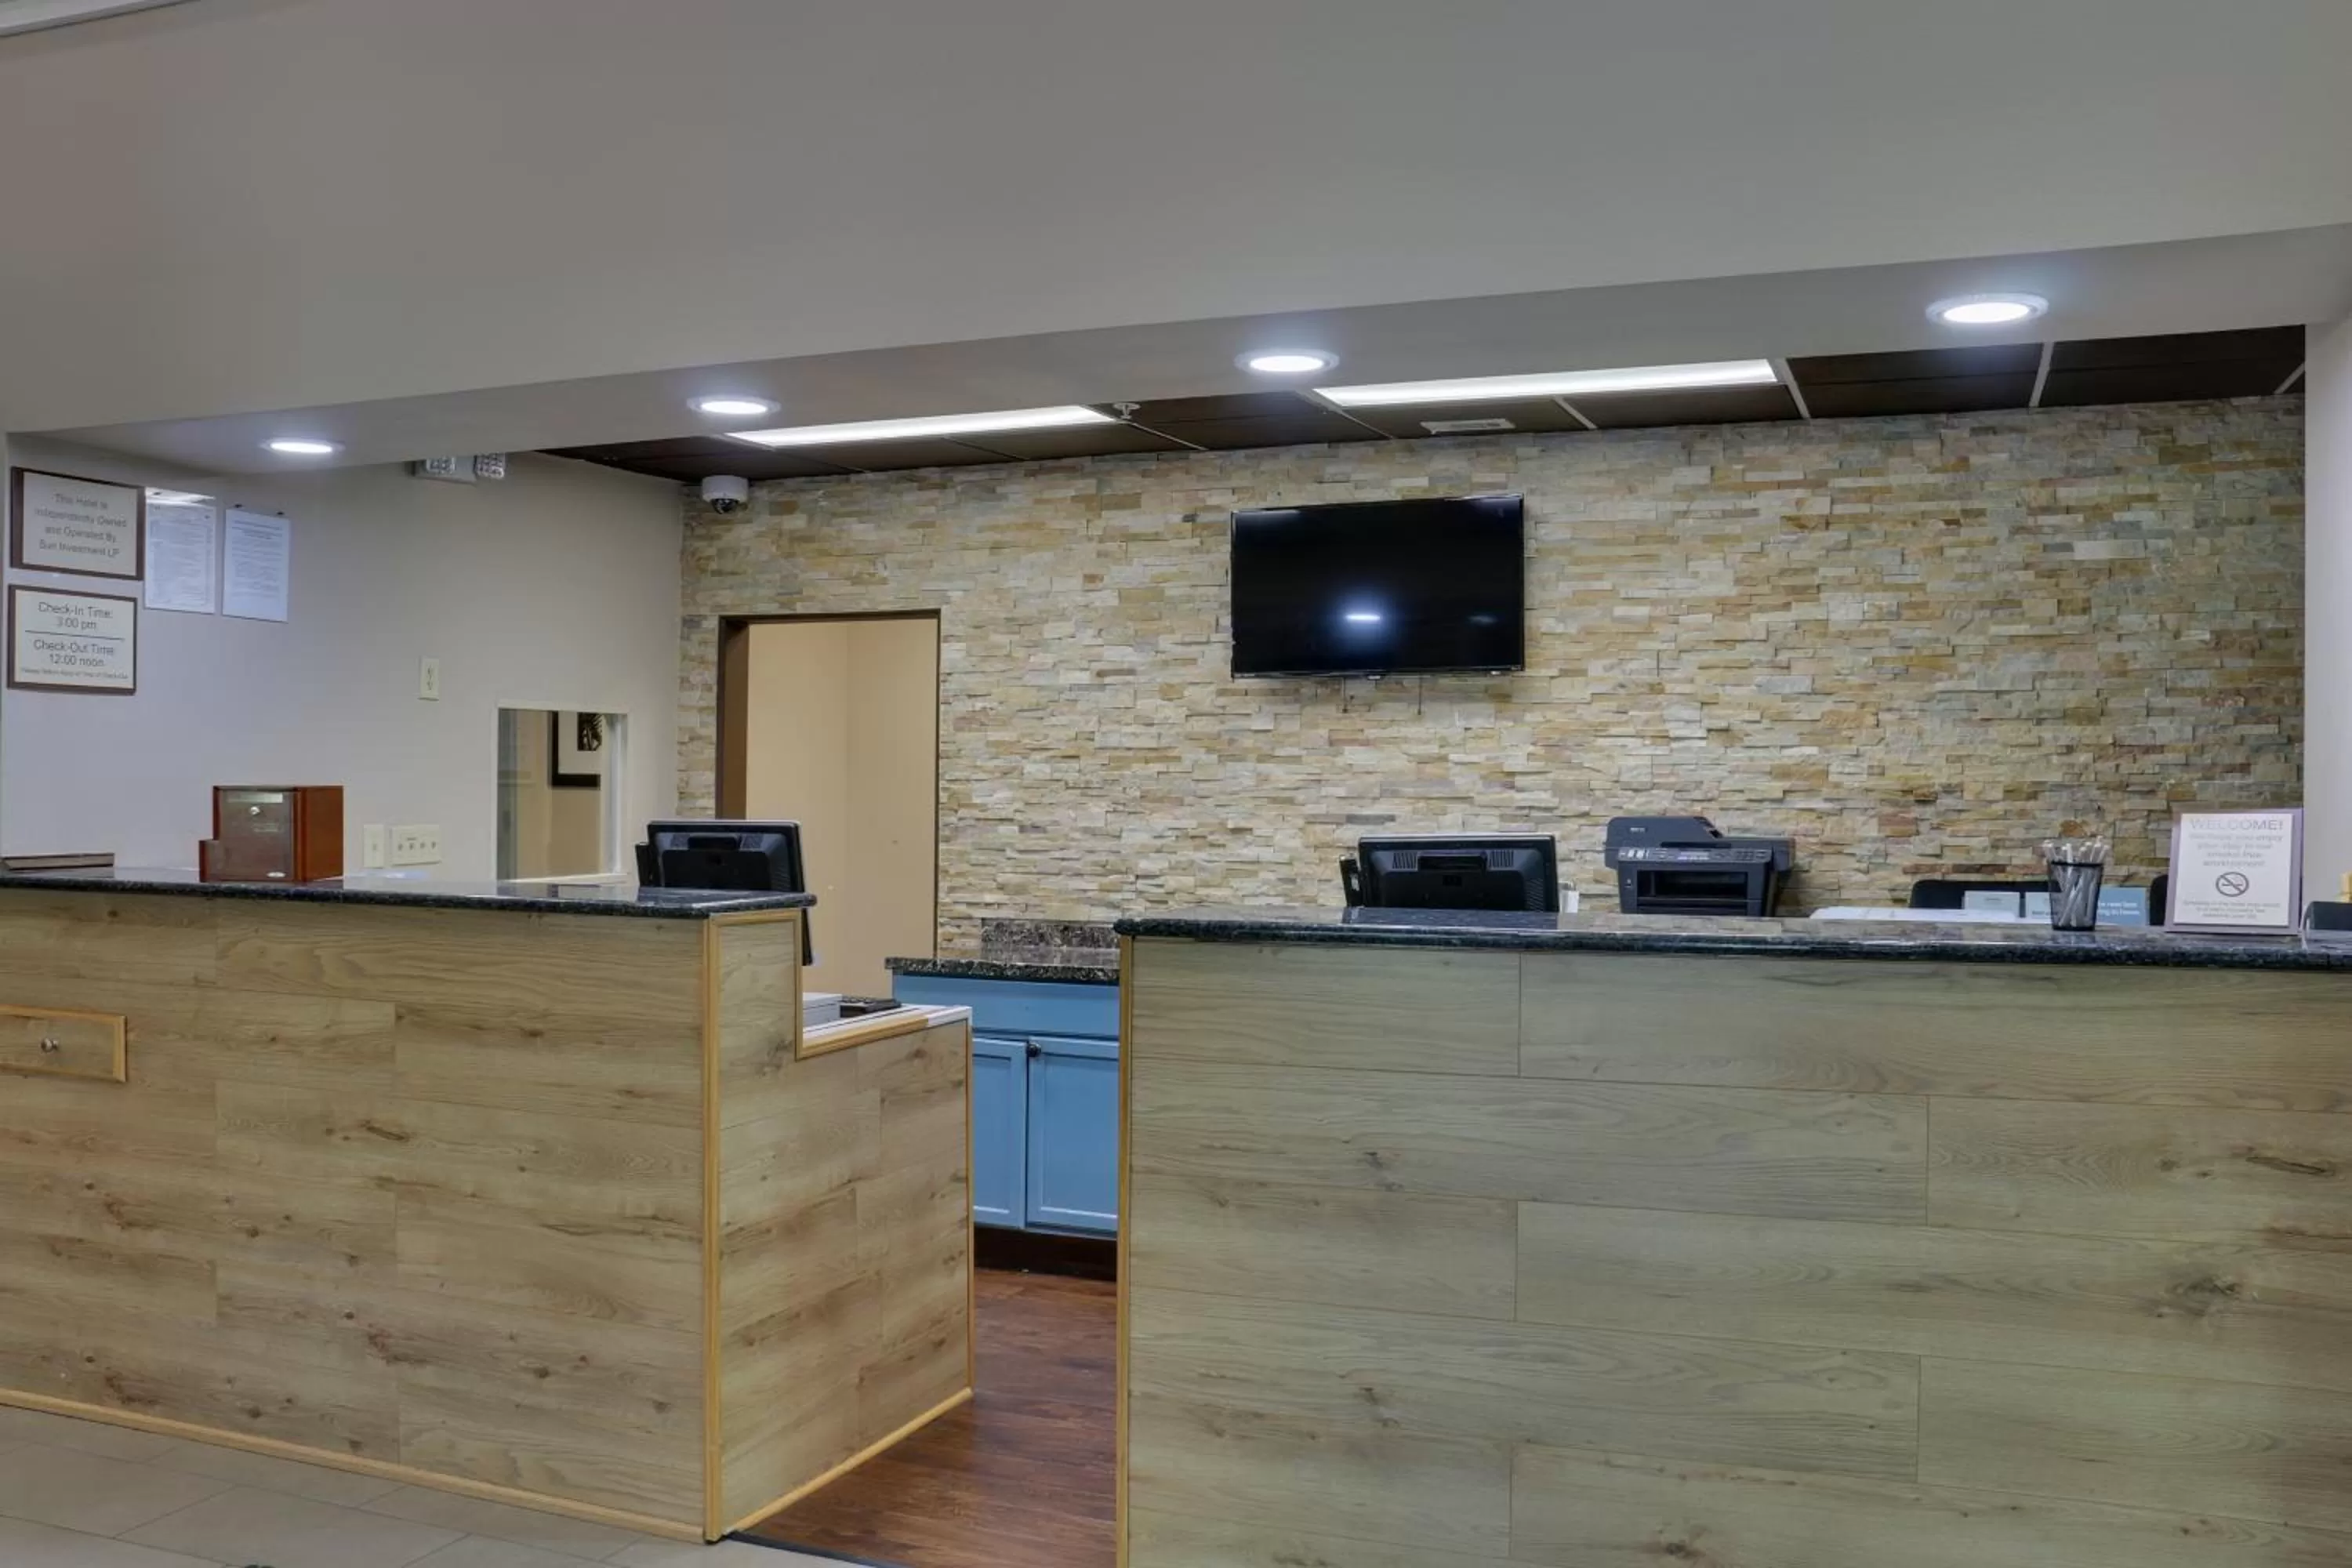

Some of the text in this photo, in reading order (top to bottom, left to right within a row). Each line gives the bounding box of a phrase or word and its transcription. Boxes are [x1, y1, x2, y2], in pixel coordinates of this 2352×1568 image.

[38, 601, 84, 615] Check-In
[81, 619, 96, 630] pm
[33, 638, 89, 653] Check-Out
[49, 653, 104, 666] 12:00 noon
[2189, 818, 2284, 831] WELCOME!
